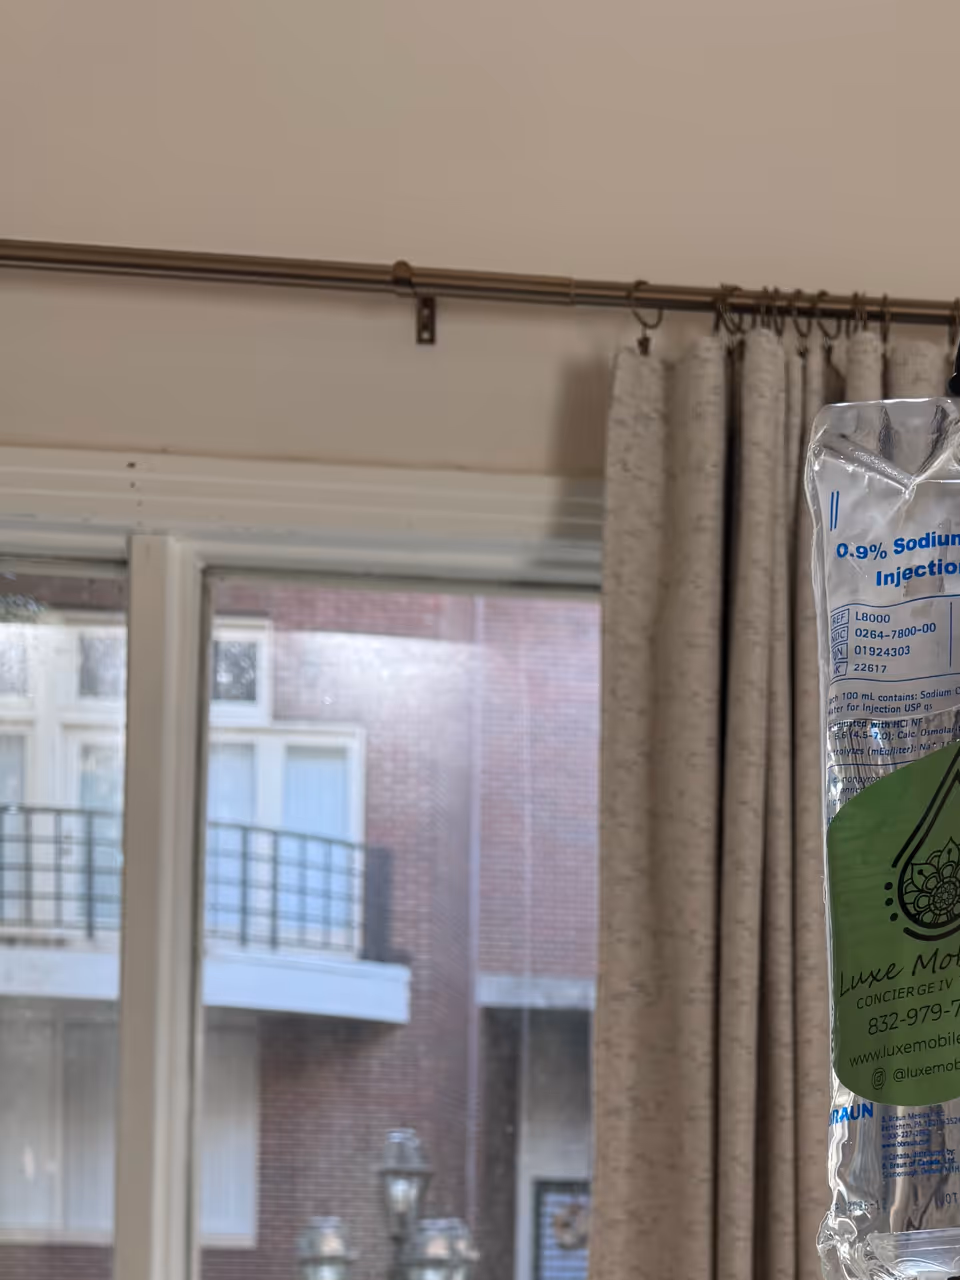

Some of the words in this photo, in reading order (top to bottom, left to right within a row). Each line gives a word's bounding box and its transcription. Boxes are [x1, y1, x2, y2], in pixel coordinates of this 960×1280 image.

[836, 542, 888, 561] 0.9%
[832, 612, 846, 627] REF
[855, 611, 891, 623] L8000
[855, 622, 937, 640] 0264-7800-00
[854, 645, 911, 657] 01924303
[853, 663, 888, 674] 22617
[842, 692, 859, 701] 100
[861, 691, 875, 701] mL
[877, 694, 918, 703] contains:
[920, 689, 952, 699] Sodium
[845, 702, 860, 712] for
[862, 703, 901, 714] Injection
[904, 703, 922, 713] USP
[911, 717, 924, 726] NF
[840, 962, 905, 998] Luxe
[856, 982, 935, 1009] CONCIERGE
[937, 977, 954, 992] IV
